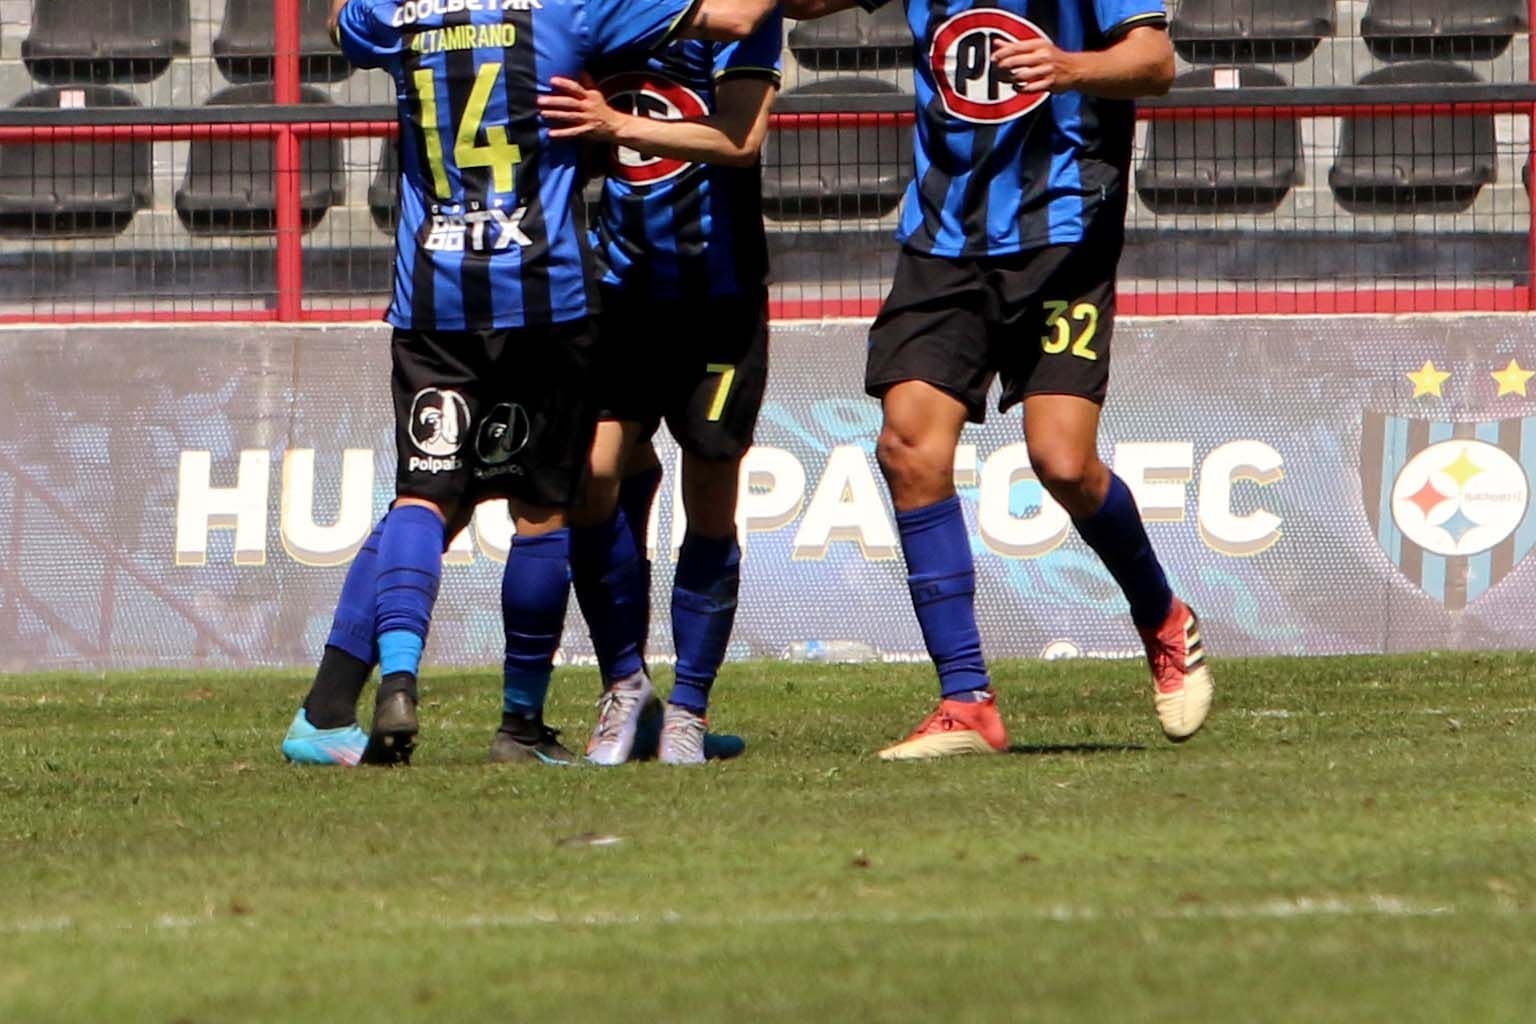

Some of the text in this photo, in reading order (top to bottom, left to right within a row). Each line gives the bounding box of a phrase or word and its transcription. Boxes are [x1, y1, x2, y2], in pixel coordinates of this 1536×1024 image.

[411, 23, 516, 54] ALTAMIRANO
[413, 62, 522, 199] 14
[1041, 300, 1099, 361] 32
[706, 363, 736, 422] 7
